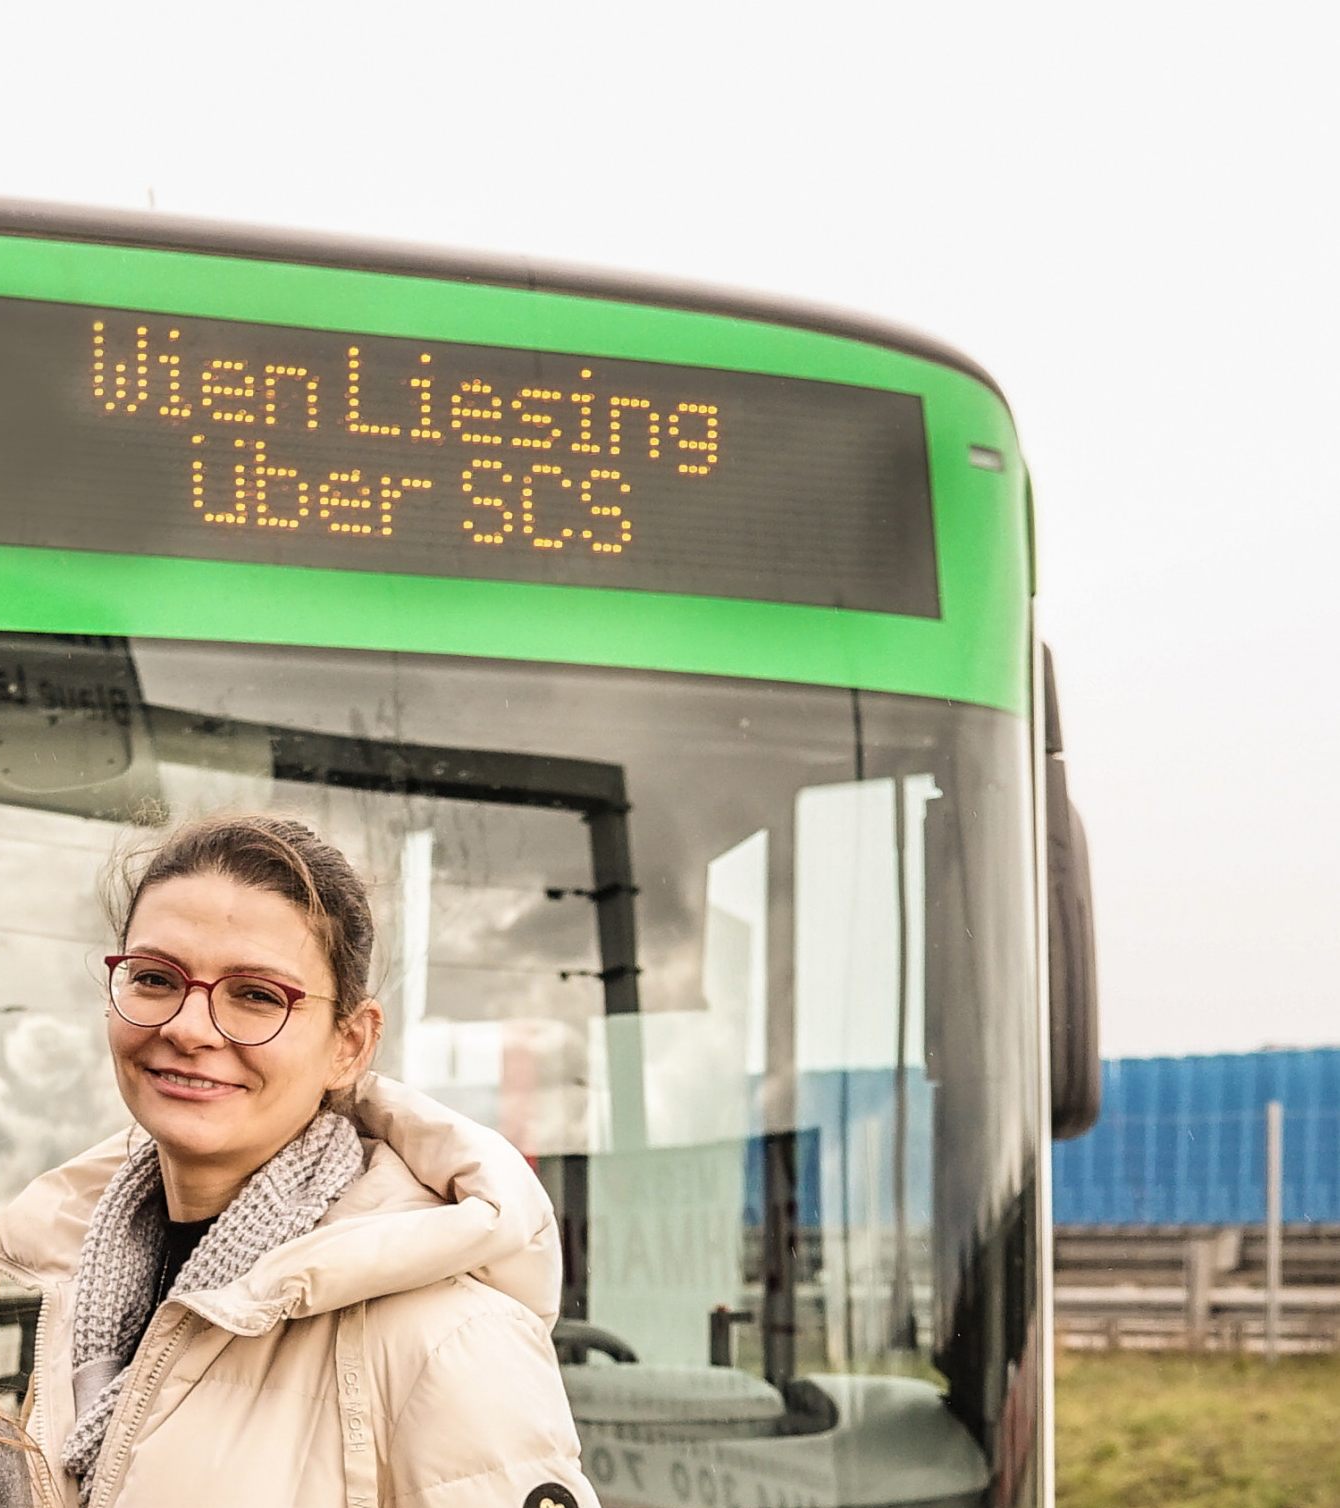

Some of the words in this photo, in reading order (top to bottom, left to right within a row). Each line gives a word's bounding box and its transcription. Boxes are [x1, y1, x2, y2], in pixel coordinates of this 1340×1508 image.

[92, 320, 318, 430] Wien
[348, 345, 720, 475] Liesing
[461, 458, 633, 553] SCS
